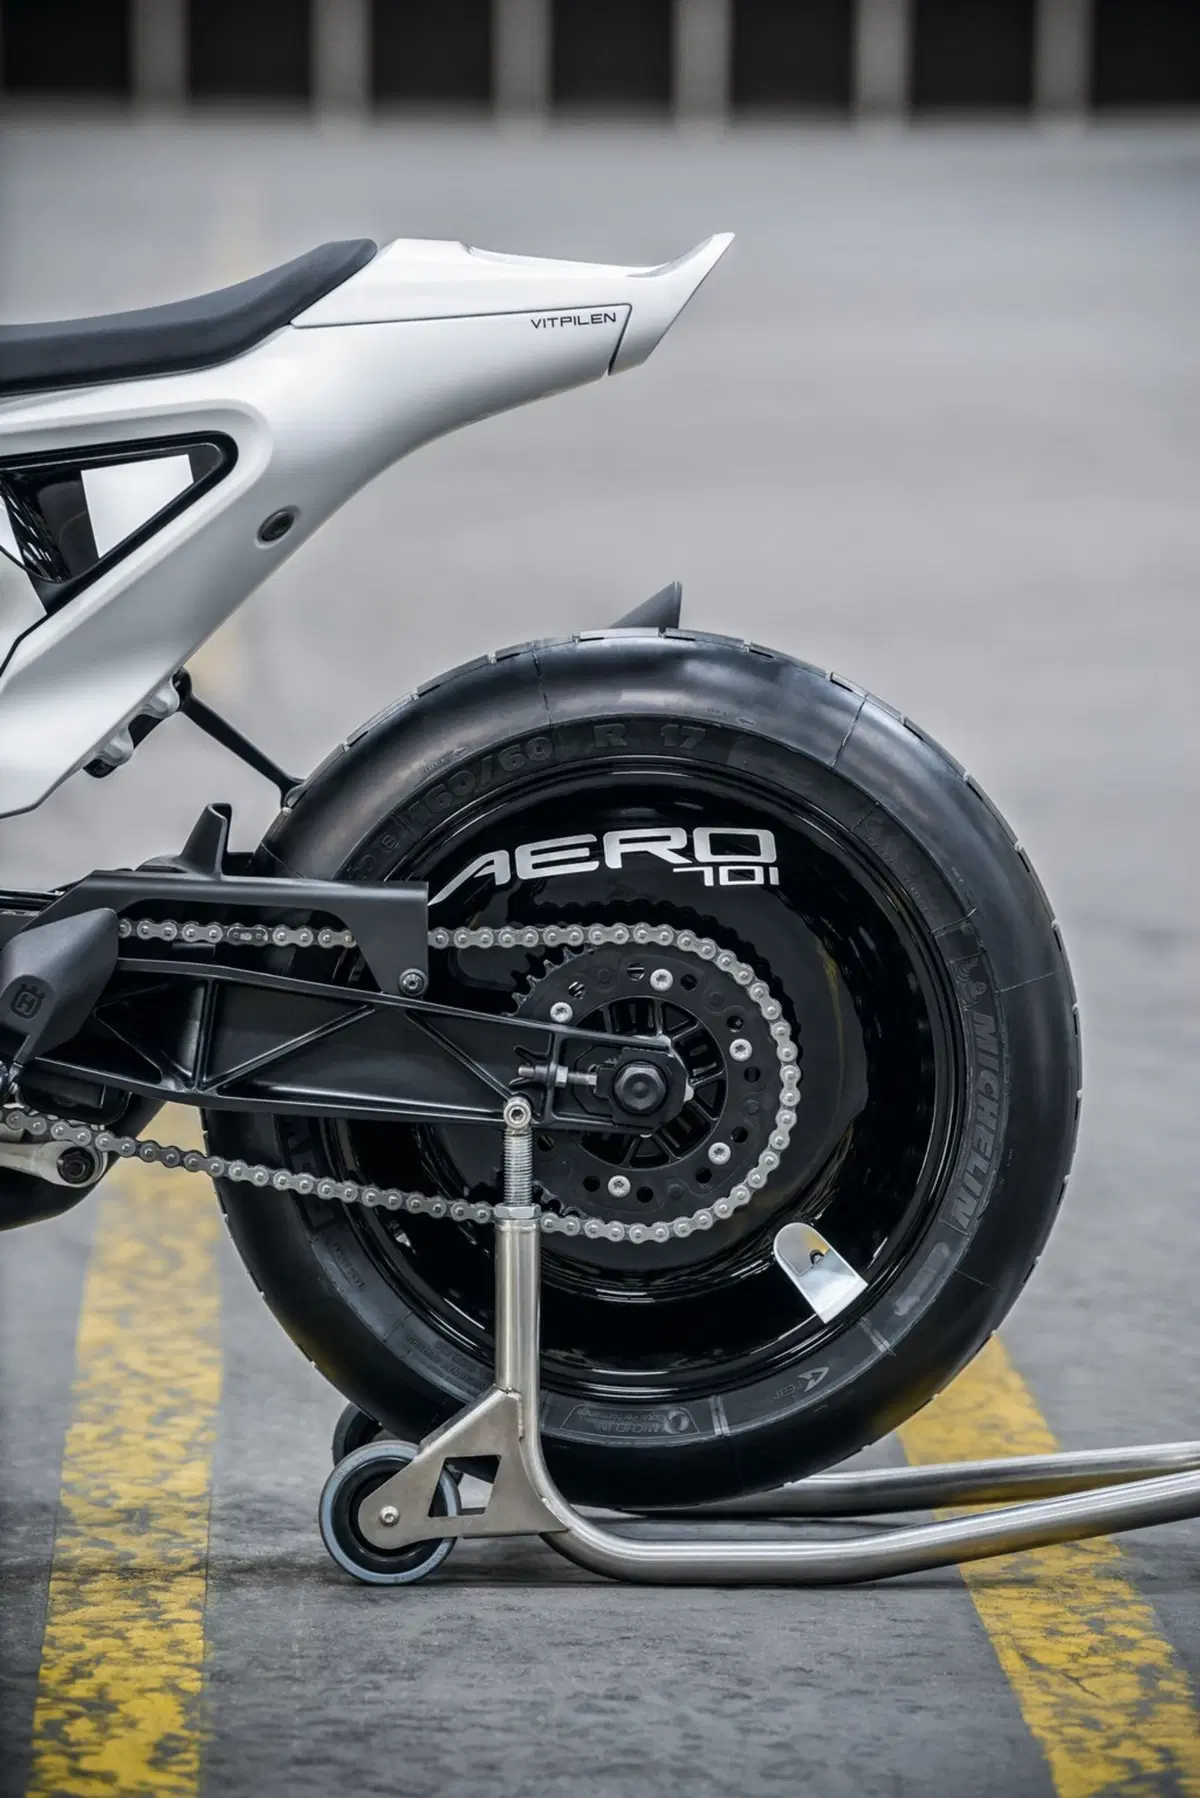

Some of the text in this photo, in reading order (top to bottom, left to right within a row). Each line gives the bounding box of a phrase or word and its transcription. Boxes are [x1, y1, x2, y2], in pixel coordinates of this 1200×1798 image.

[530, 312, 617, 329] VITPILEN
[594, 723, 628, 748] R
[660, 723, 706, 748] 17
[427, 826, 777, 906] AERO
[950, 1012, 1001, 1228] MICHELIN
